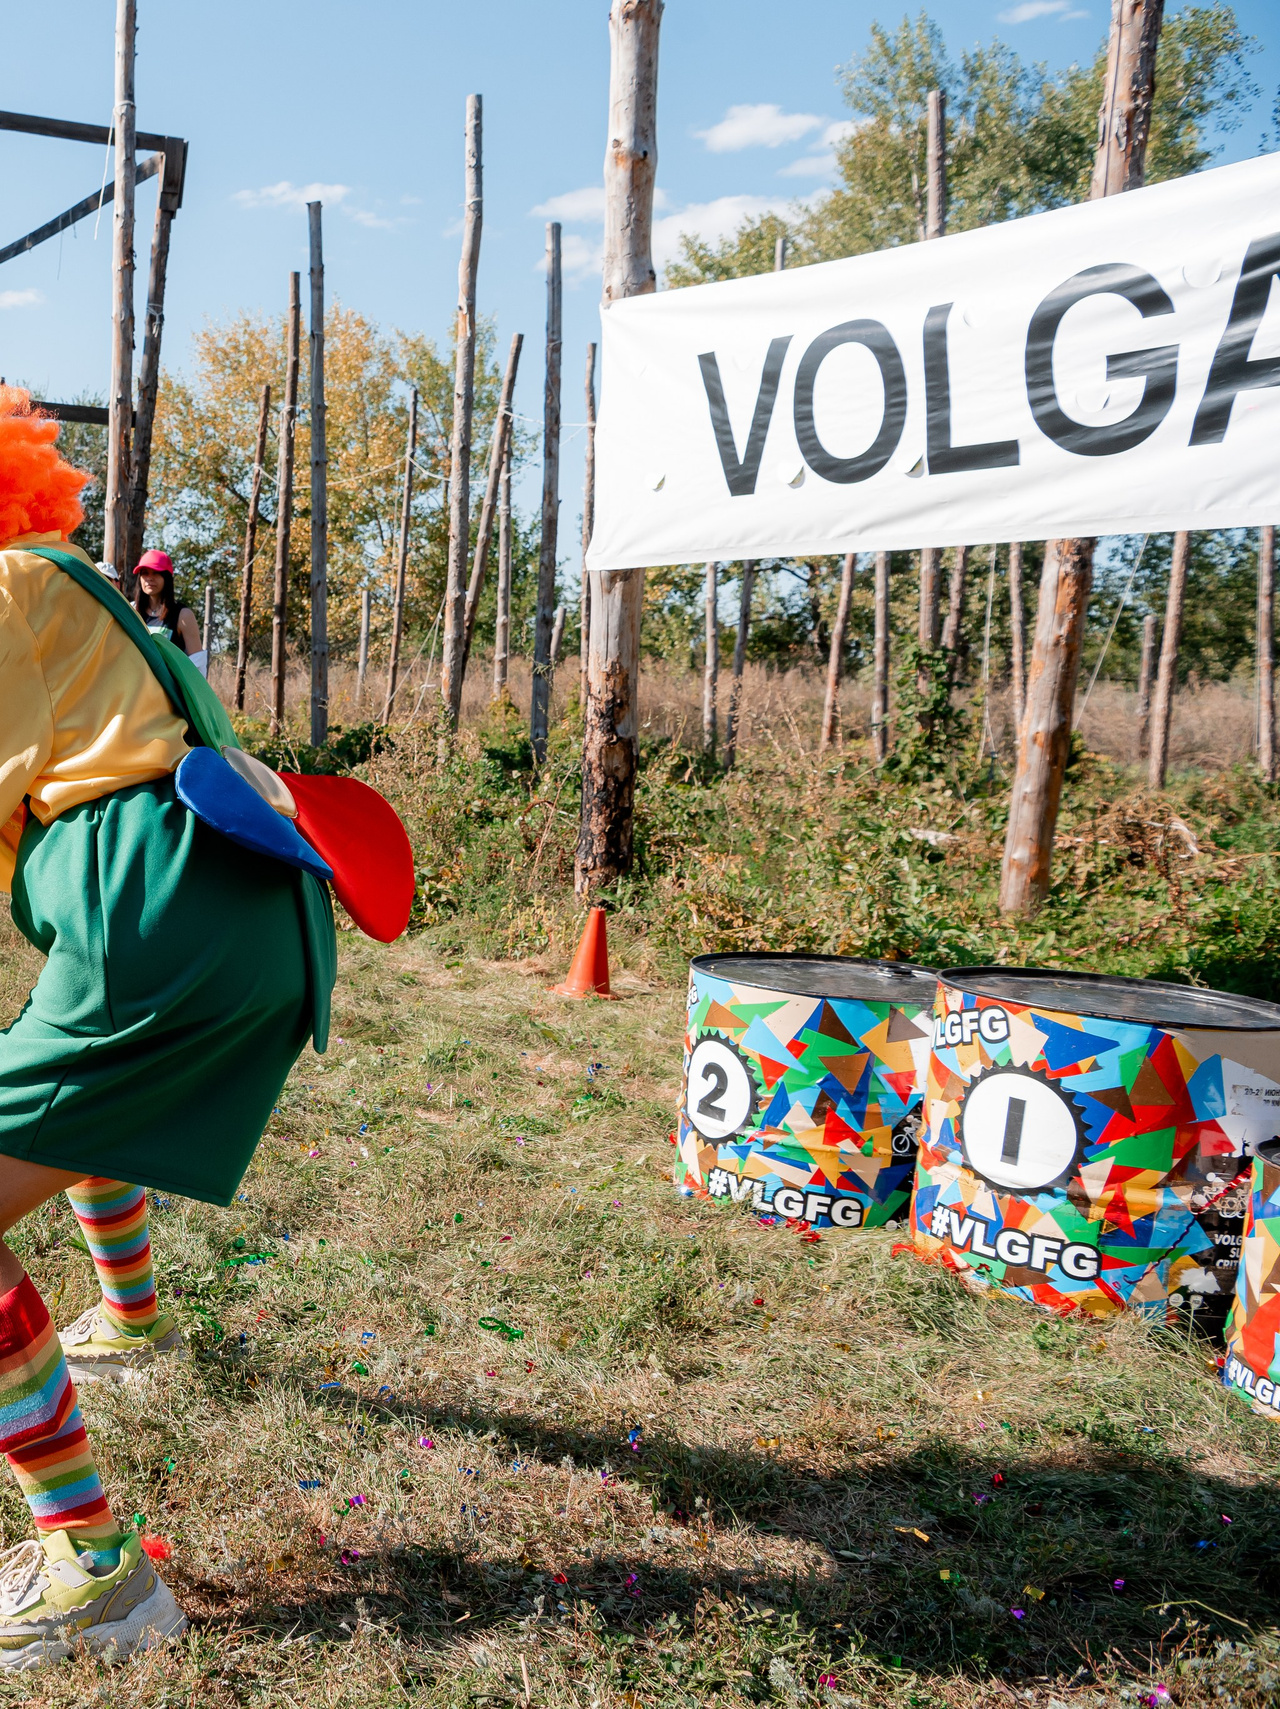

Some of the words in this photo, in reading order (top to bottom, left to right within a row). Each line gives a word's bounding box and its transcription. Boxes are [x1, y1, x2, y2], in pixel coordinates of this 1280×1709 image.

[698, 232, 1280, 497] VOLGA
[697, 1062, 728, 1122] 2
[708, 1167, 863, 1227] #VLGFG
[930, 1203, 1102, 1280] #VLGFG
